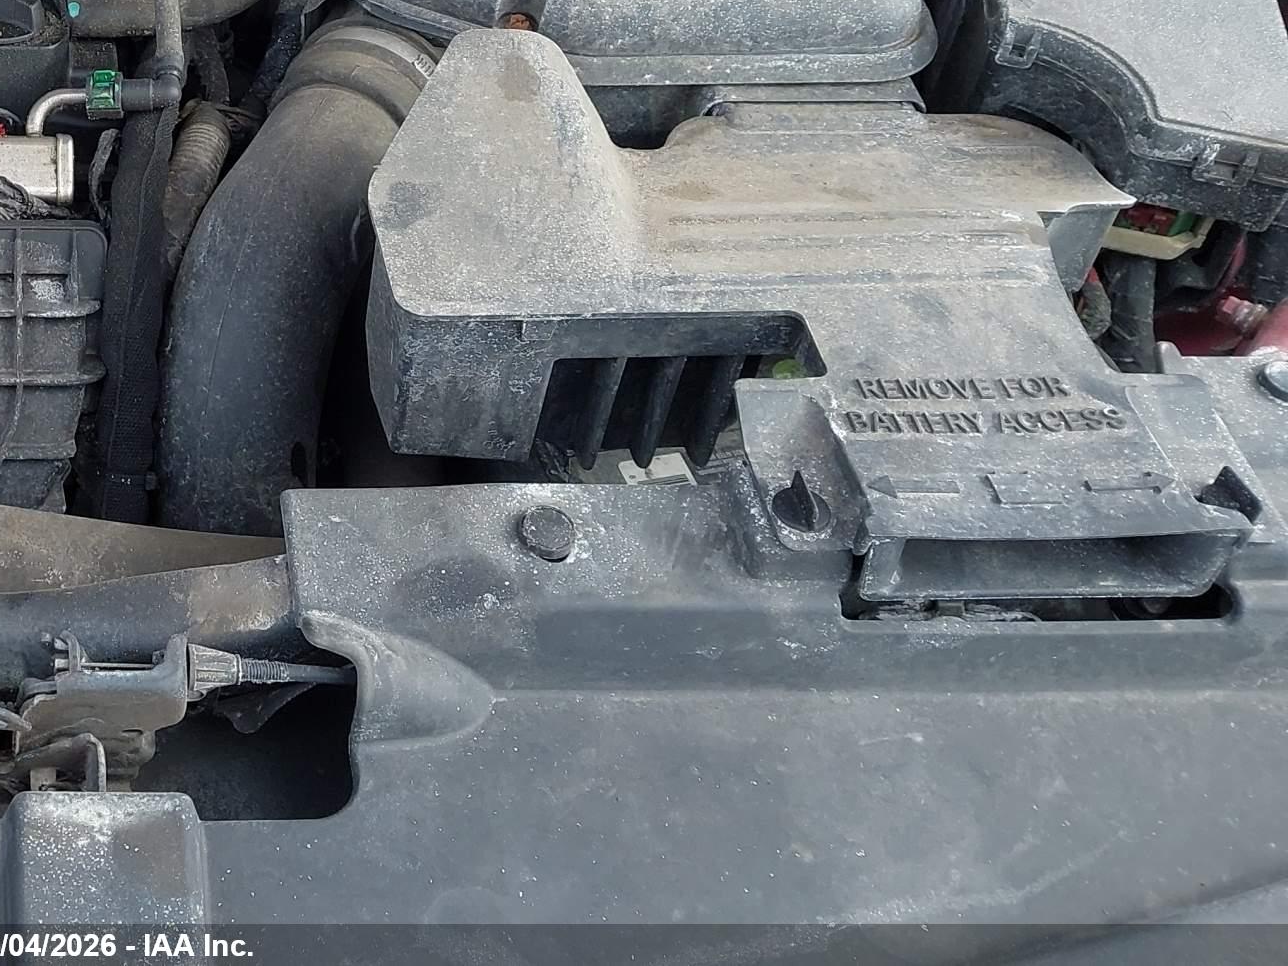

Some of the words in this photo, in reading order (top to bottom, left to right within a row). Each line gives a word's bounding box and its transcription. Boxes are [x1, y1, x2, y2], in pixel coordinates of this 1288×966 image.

[855, 377, 996, 401] REMOVE
[998, 376, 1069, 400] FOR
[845, 411, 984, 434] BATTERY
[998, 406, 1127, 433] ACCESS
